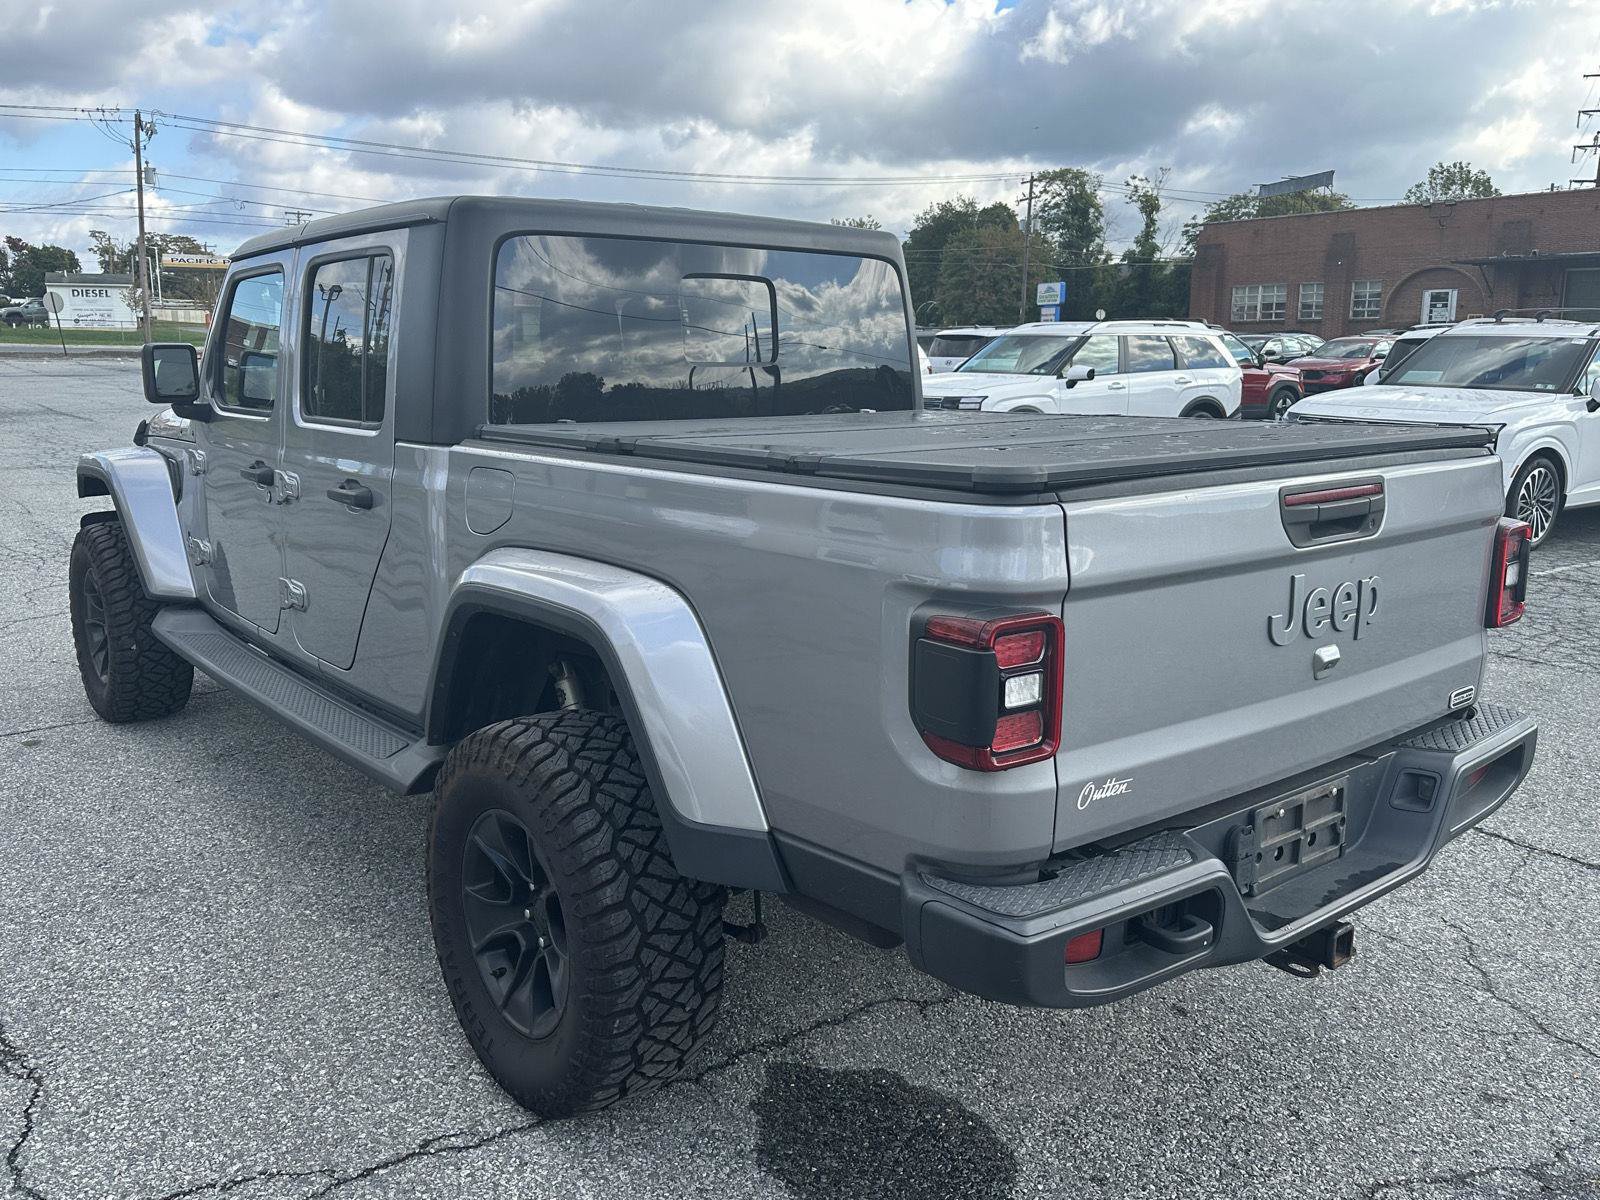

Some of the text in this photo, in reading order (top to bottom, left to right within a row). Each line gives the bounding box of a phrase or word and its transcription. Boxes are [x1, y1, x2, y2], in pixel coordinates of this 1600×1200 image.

[171, 257, 218, 265] PACIFIC
[71, 289, 111, 298] DIESEL
[1267, 574, 1382, 646] Jeep
[1076, 777, 1134, 811] Outten
